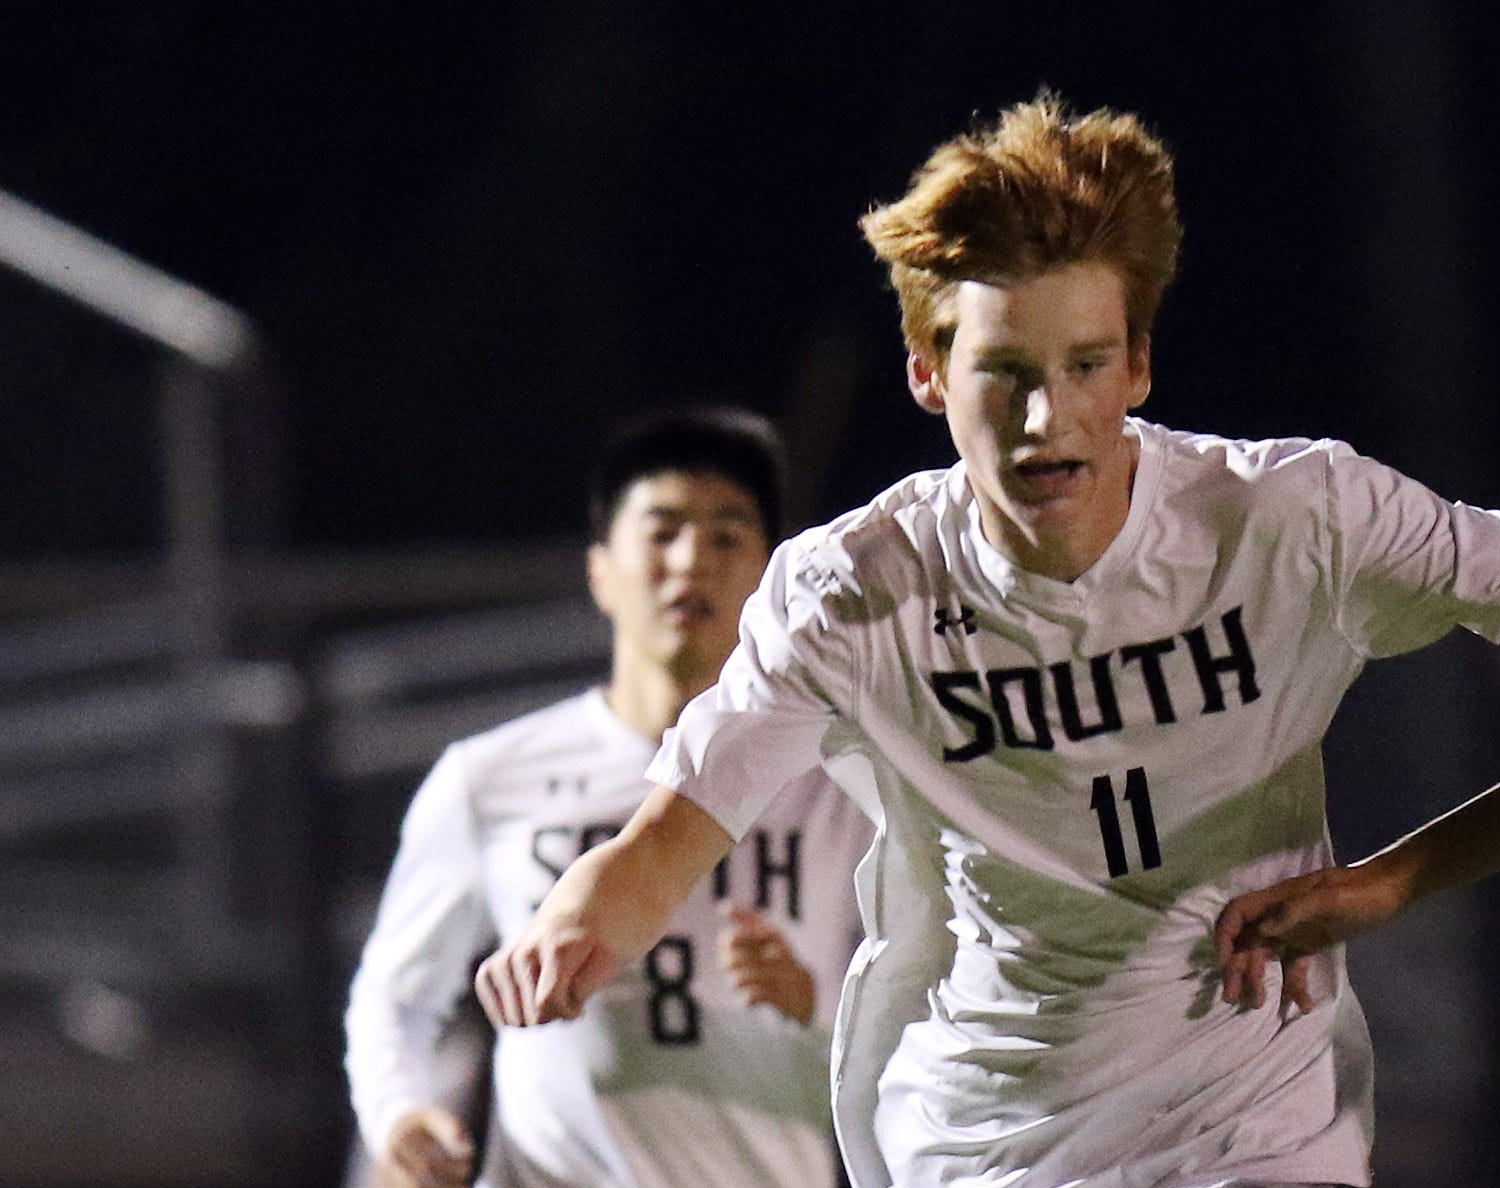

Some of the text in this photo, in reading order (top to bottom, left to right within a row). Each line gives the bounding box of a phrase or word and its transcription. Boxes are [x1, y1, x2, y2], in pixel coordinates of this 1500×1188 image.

[930, 605, 1262, 763] SOUTH
[1089, 766, 1162, 878] 11
[645, 934, 700, 1046] 8
